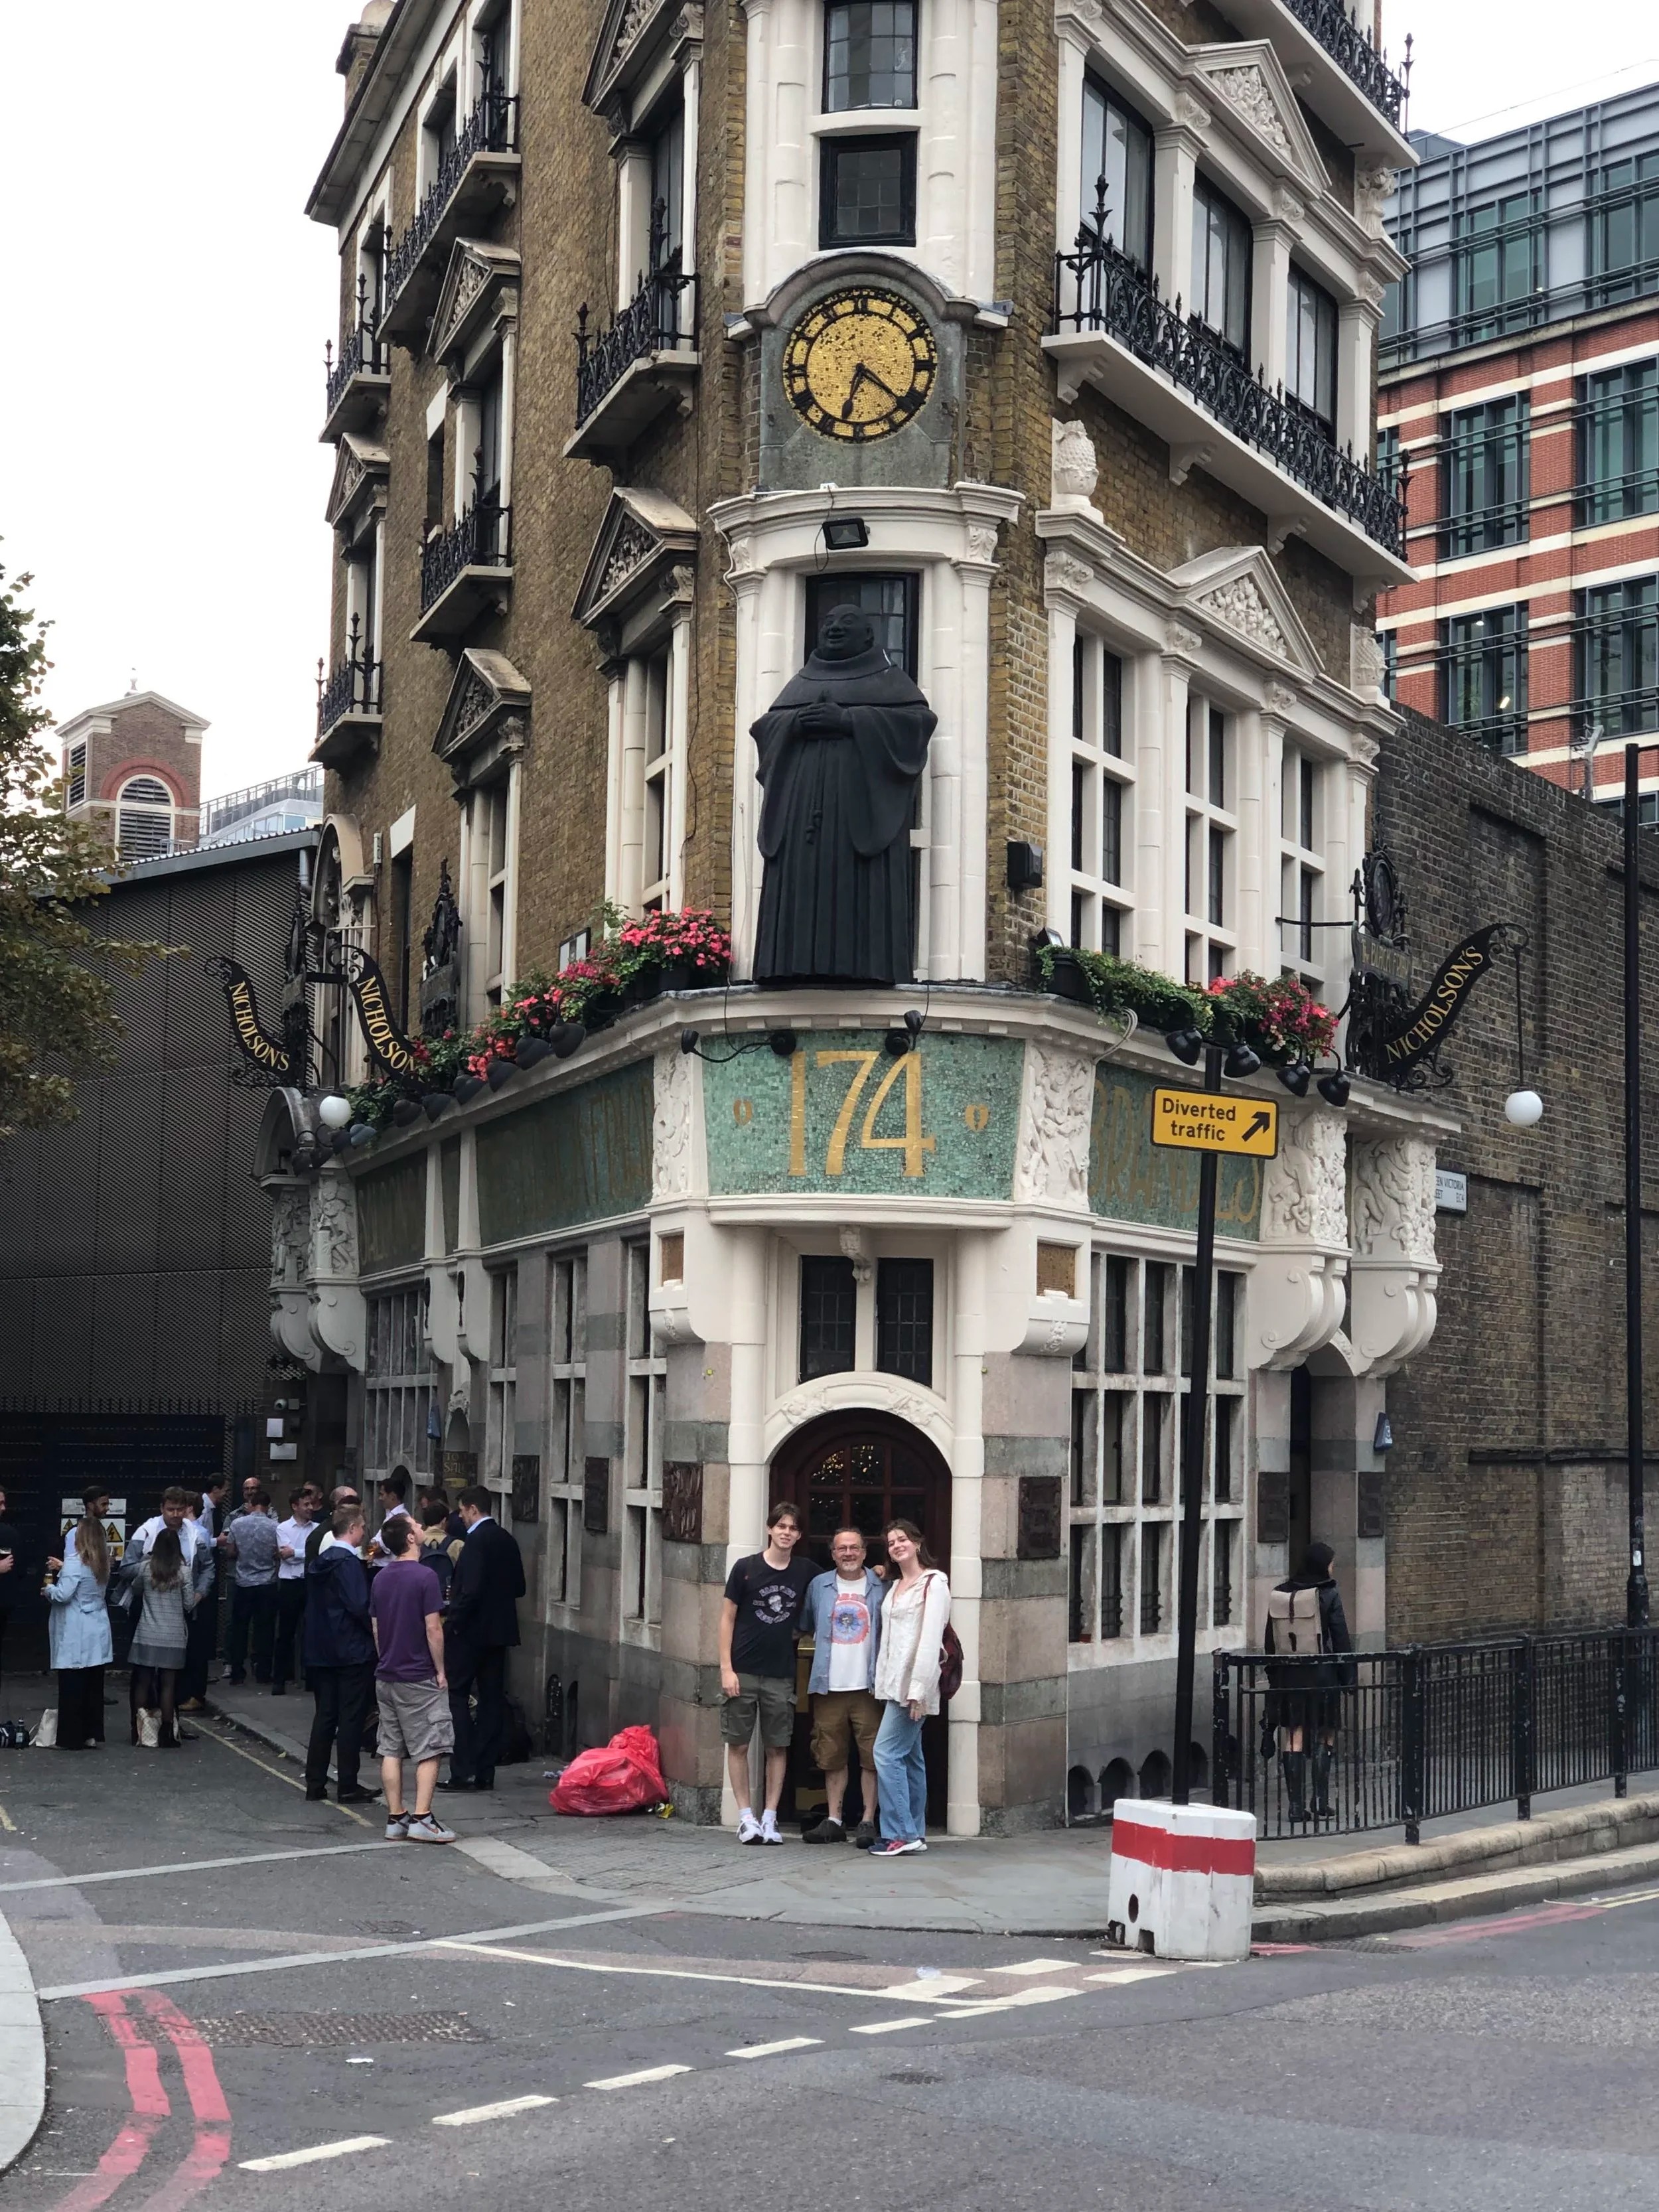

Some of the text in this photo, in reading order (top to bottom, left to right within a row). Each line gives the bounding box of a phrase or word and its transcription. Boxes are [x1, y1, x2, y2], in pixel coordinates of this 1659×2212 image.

[229, 981, 291, 1071] NICHOLSON'S
[1385, 945, 1483, 1065] NICHOLSON'S
[787, 1051, 936, 1177] 174
[1163, 1098, 1236, 1122] Diverted
[1171, 1120, 1226, 1142] traffic
[1444, 1177, 1464, 1191] VICTORIA
